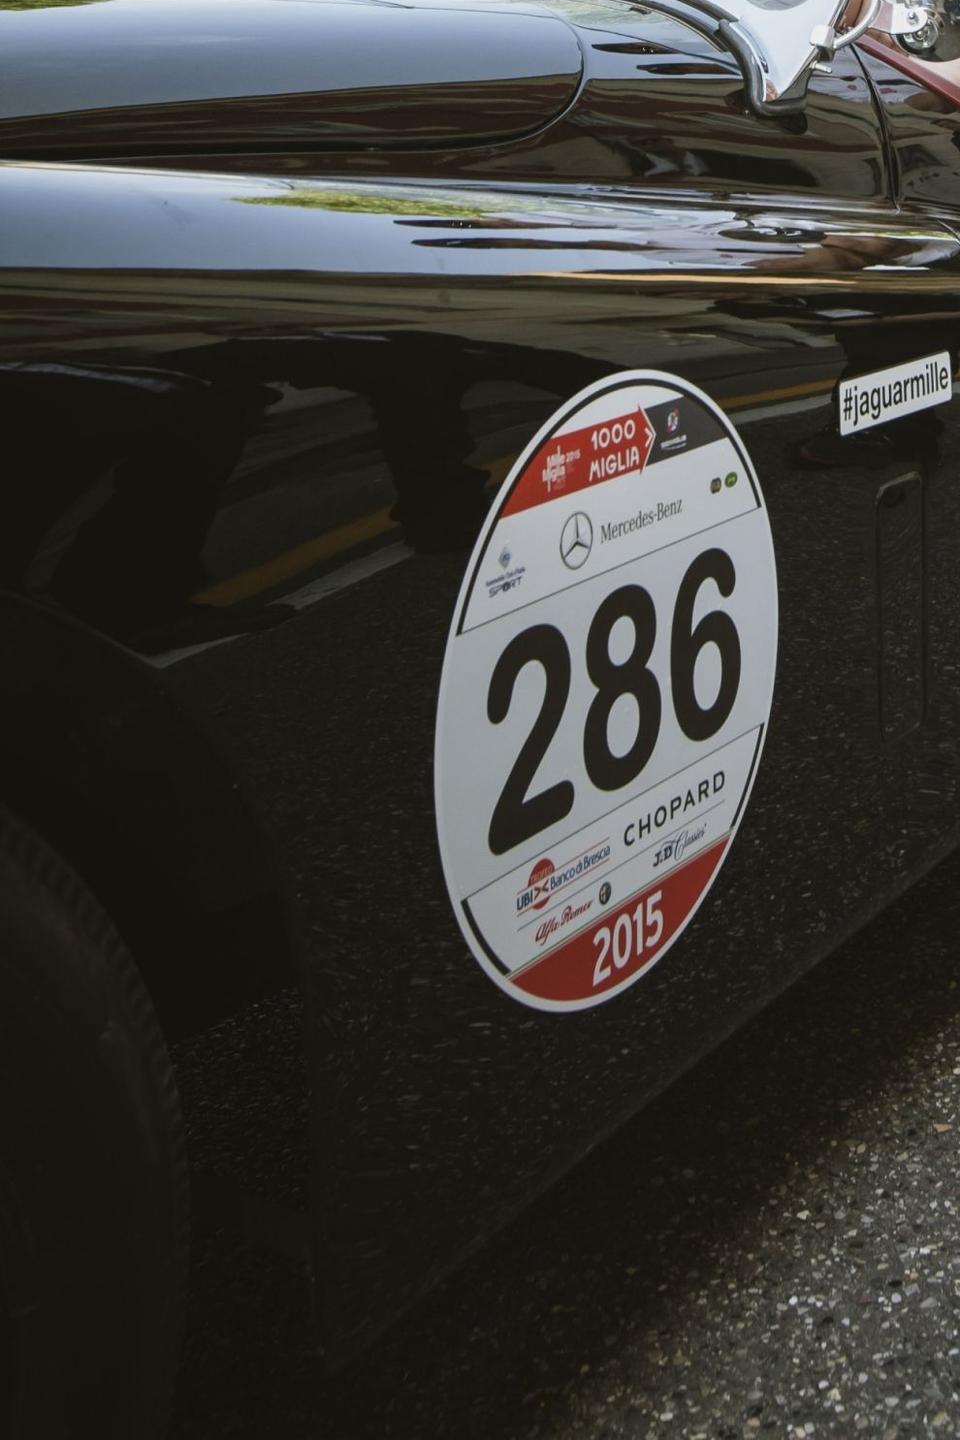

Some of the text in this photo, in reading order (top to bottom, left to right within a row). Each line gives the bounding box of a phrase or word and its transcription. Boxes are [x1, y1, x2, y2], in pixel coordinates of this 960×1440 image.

[843, 361, 949, 426] #jaguarmille
[589, 446, 640, 482] MIGLIA
[591, 419, 636, 451] 1000
[600, 499, 683, 544] Mercedes-Benz
[486, 547, 742, 855] 286
[623, 770, 725, 847] CHOPARD
[516, 889, 533, 911] UBI
[550, 868, 575, 891] Banco
[583, 845, 611, 870] Brescia
[593, 890, 664, 987] 2015
